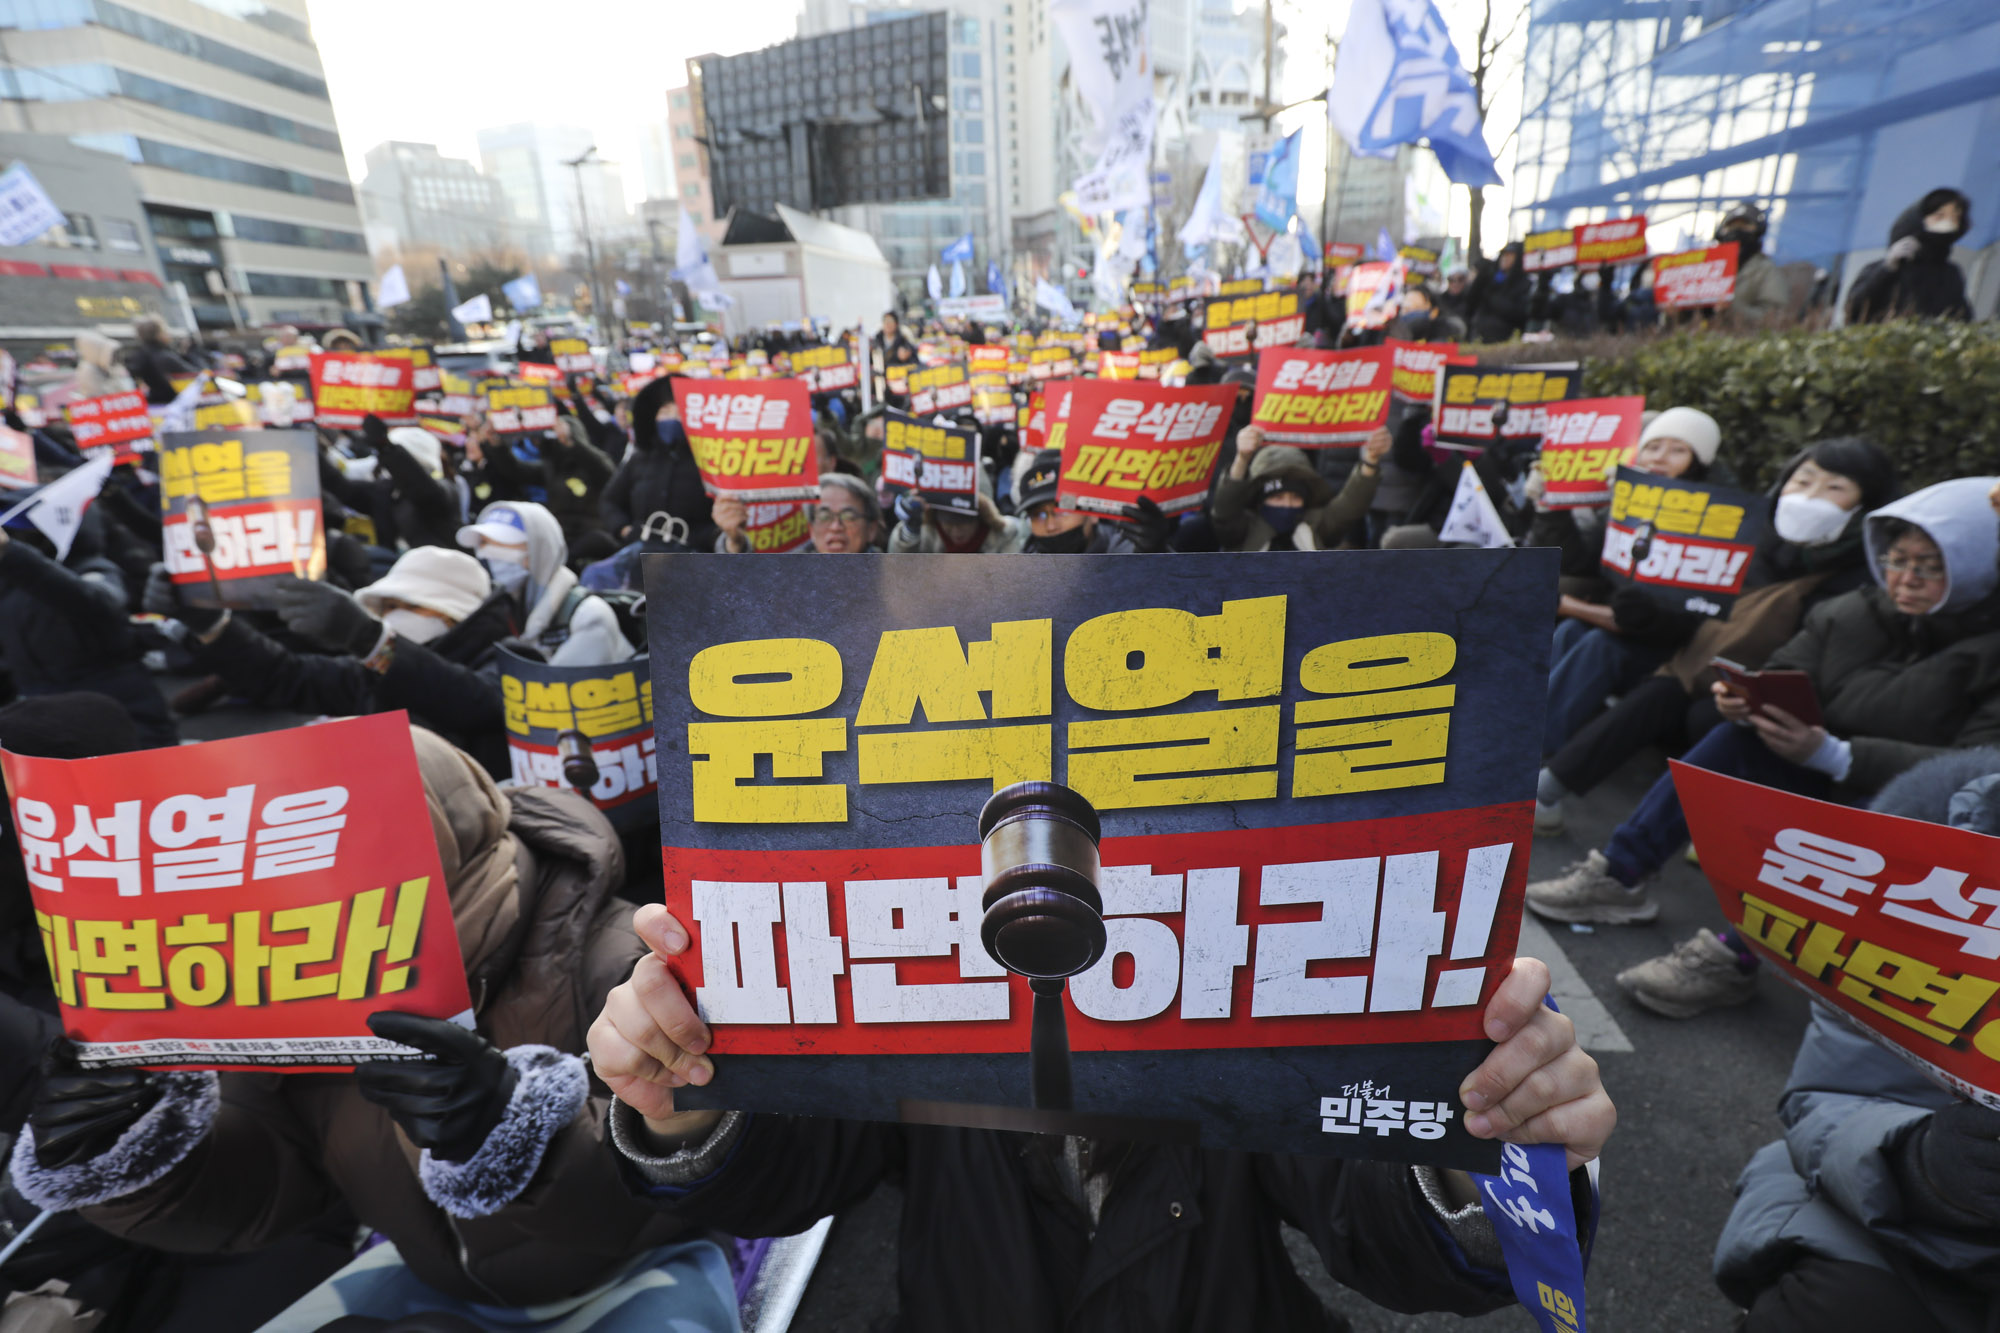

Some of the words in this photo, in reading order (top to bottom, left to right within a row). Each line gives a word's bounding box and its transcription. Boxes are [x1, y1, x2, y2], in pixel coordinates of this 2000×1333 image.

[1273, 358, 1380, 392] 윤석열을
[685, 392, 790, 431] 윤석열을
[1092, 398, 1223, 443] 윤석열을
[1254, 389, 1388, 426] 파면하라!
[1063, 441, 1223, 491] 파면하라!
[688, 594, 1458, 823] 윤석열을
[16, 784, 349, 897] 윤석열을
[691, 843, 1514, 1023] 파면하라!
[1734, 892, 2000, 1063] 파면
[1341, 1079, 1391, 1101] 더불어
[1320, 1096, 1454, 1140] 민주당
